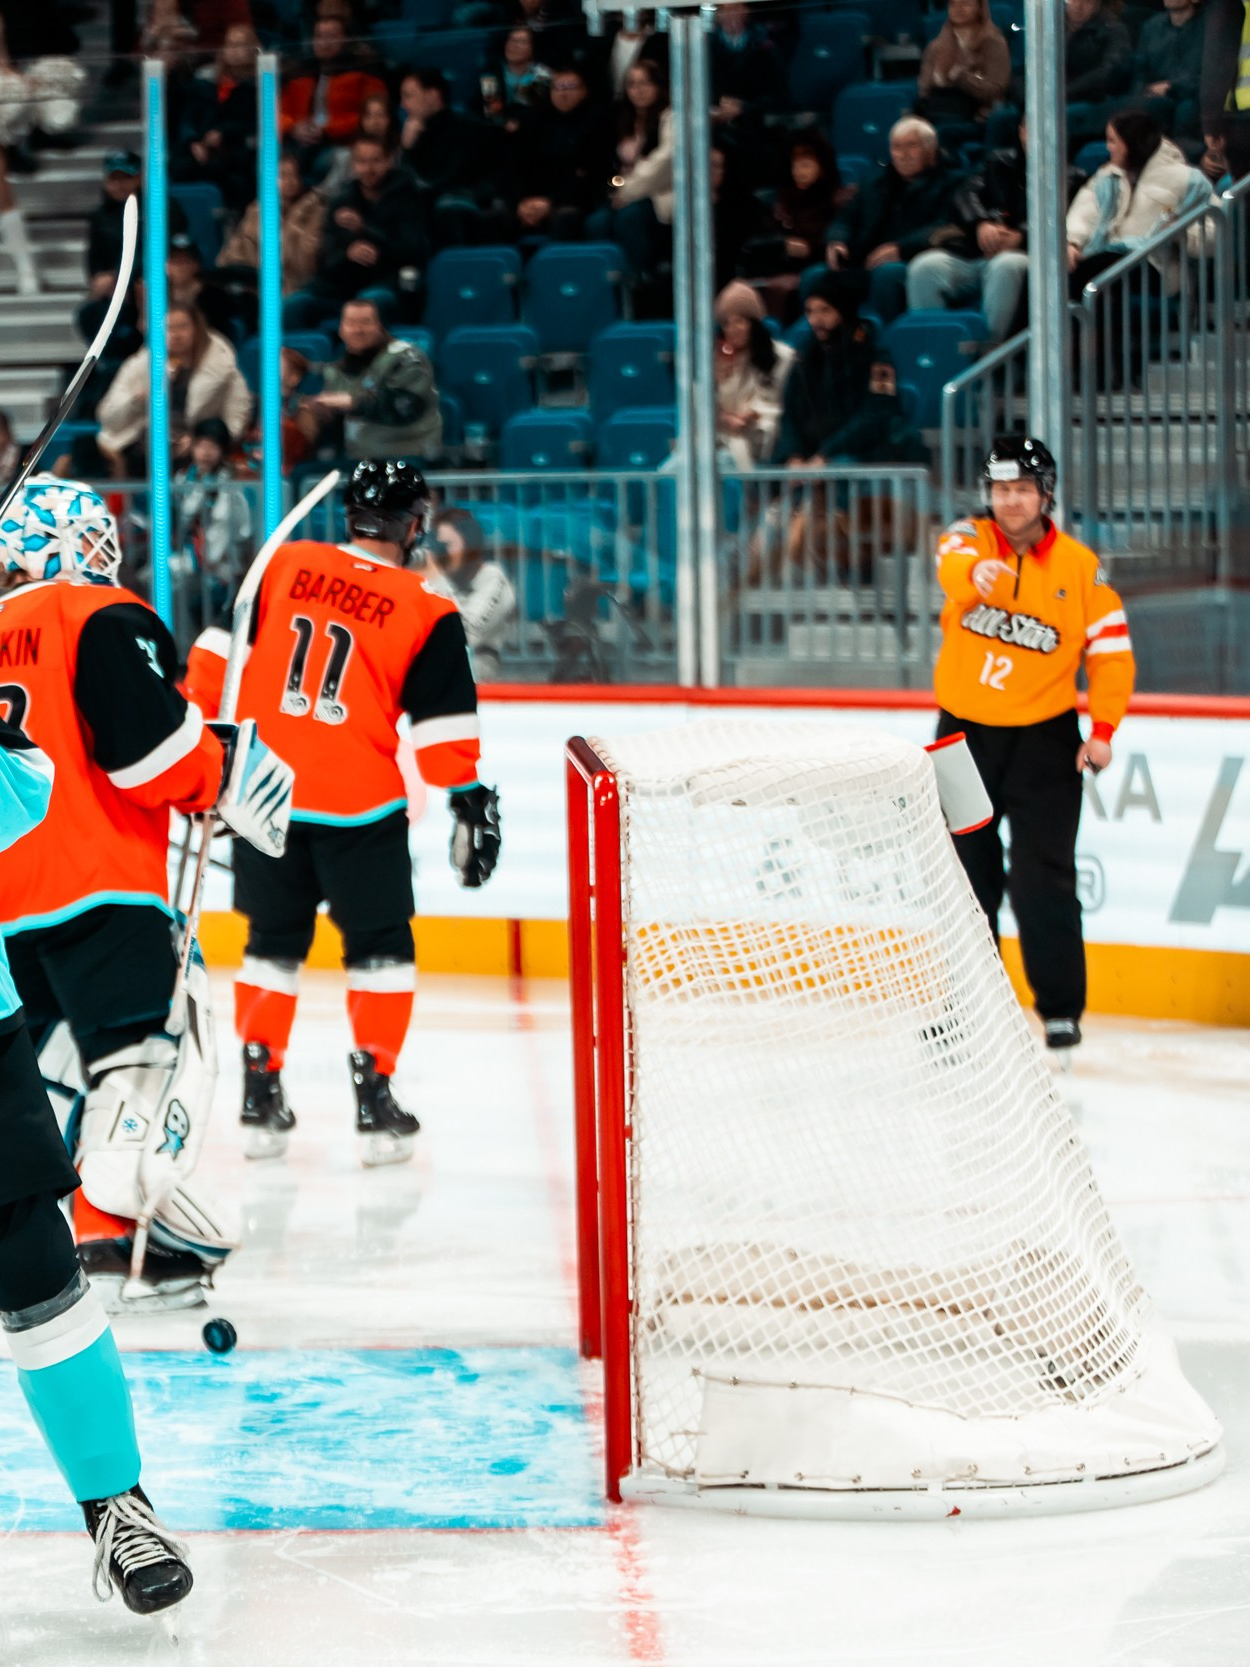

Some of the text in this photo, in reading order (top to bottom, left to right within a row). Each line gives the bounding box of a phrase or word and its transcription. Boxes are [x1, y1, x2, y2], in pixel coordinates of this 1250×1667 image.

[289, 568, 395, 629] BARBER
[279, 614, 354, 726] 11
[979, 651, 1013, 691] 12
